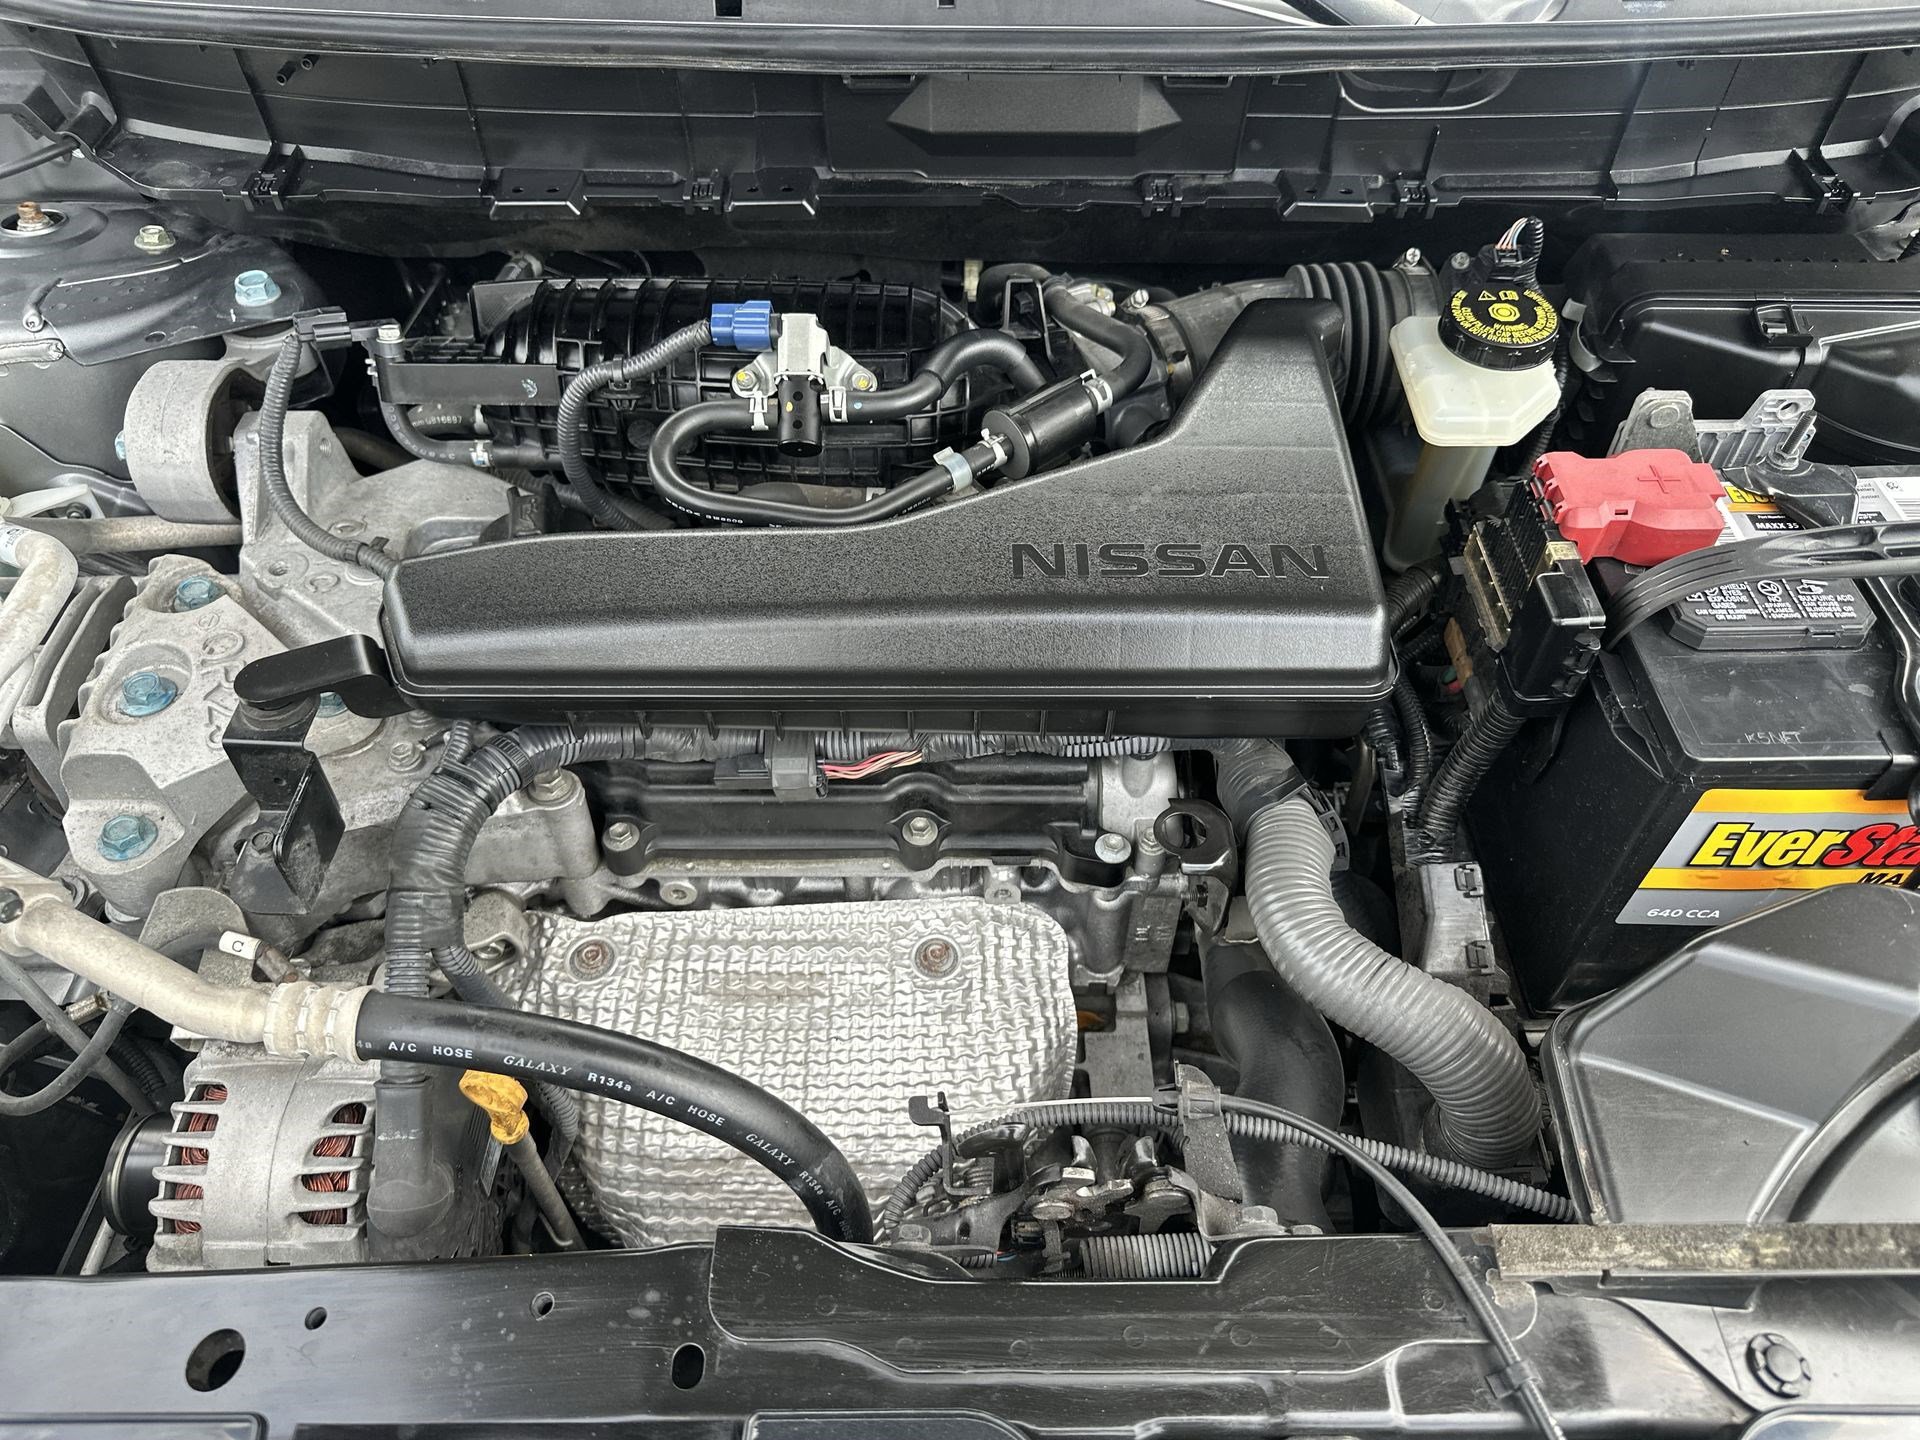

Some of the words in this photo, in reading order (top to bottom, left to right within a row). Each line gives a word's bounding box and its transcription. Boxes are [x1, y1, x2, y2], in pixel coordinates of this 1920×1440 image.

[1011, 543, 1330, 579] NISSAN
[1767, 595, 1782, 603] NO
[1798, 594, 1835, 602] SULFURIC
[1836, 594, 1855, 602] ACID
[1647, 908, 1683, 918] 640
[1685, 909, 1721, 918] CCA
[232, 940, 245, 953] C
[388, 1041, 417, 1053] A/C
[432, 1045, 473, 1060] HOSE
[502, 1055, 573, 1076] GALAXY
[587, 1072, 633, 1092] R134a
[646, 1089, 676, 1106] A/C
[687, 1104, 726, 1127] HOSE
[745, 1132, 796, 1168] GALAXY
[798, 1170, 824, 1196] R134a
[825, 1199, 842, 1216] A/C
